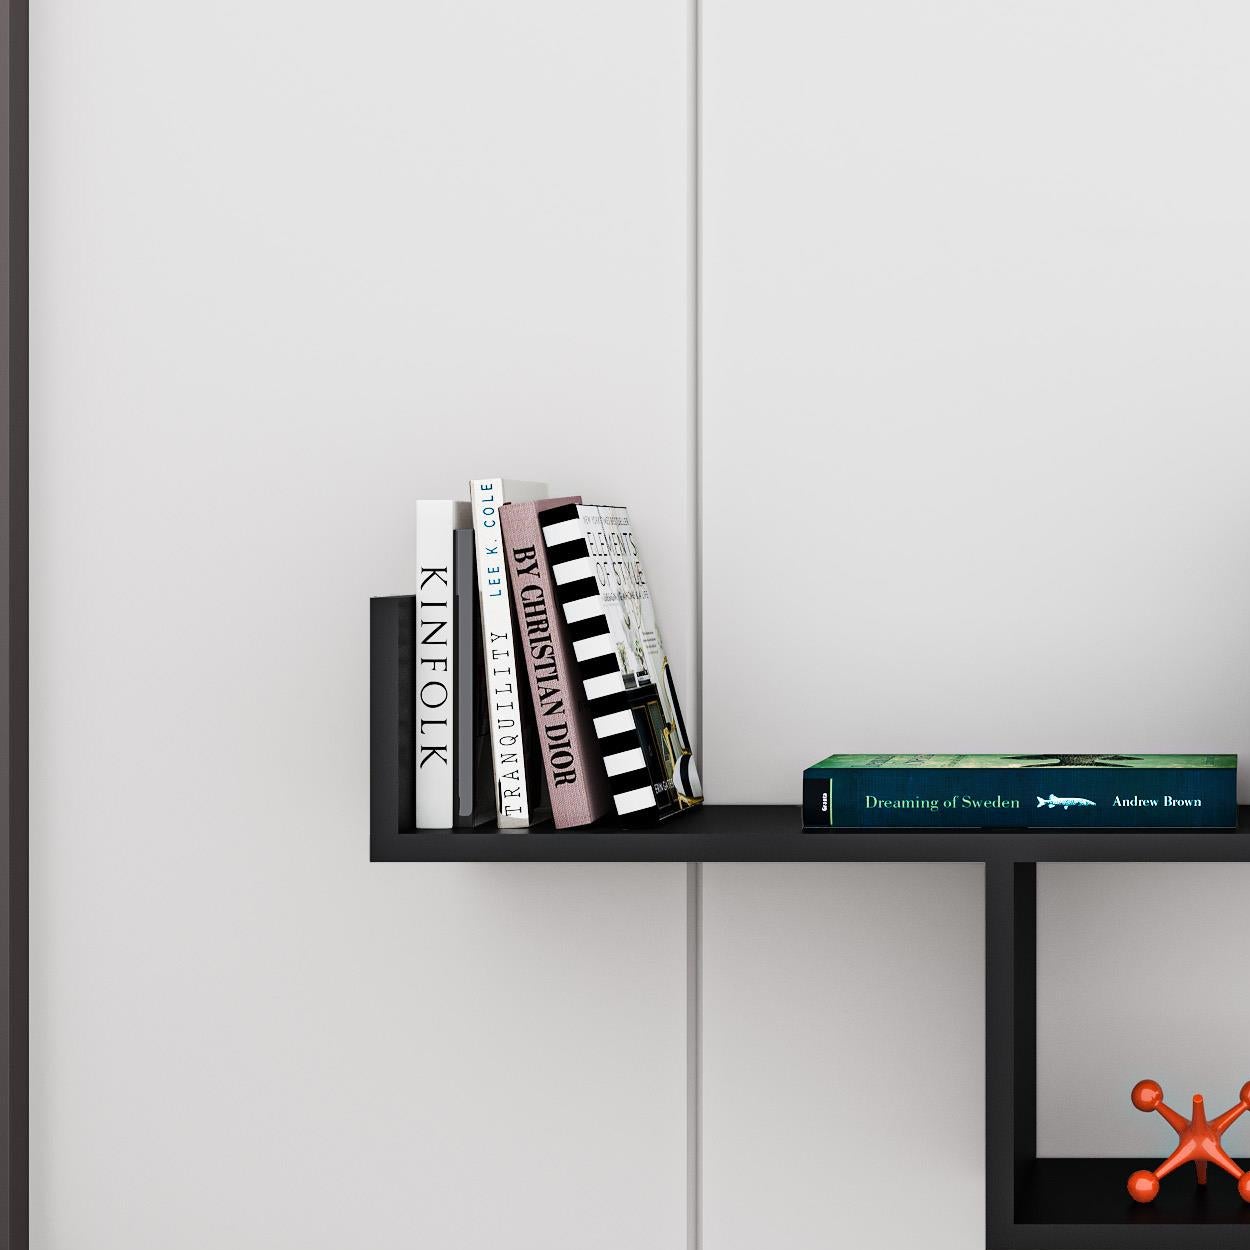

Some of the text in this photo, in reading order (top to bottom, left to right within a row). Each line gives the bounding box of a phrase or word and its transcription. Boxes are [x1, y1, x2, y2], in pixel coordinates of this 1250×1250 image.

[420, 566, 448, 769] KINFOLK
[480, 482, 522, 816] TRANQUILITY LEE K. COLE
[513, 544, 578, 788] BY CHRISTIAN DIOR
[865, 793, 1020, 811] Dreaming of Sweden
[1113, 795, 1203, 808] Andrew Brown
